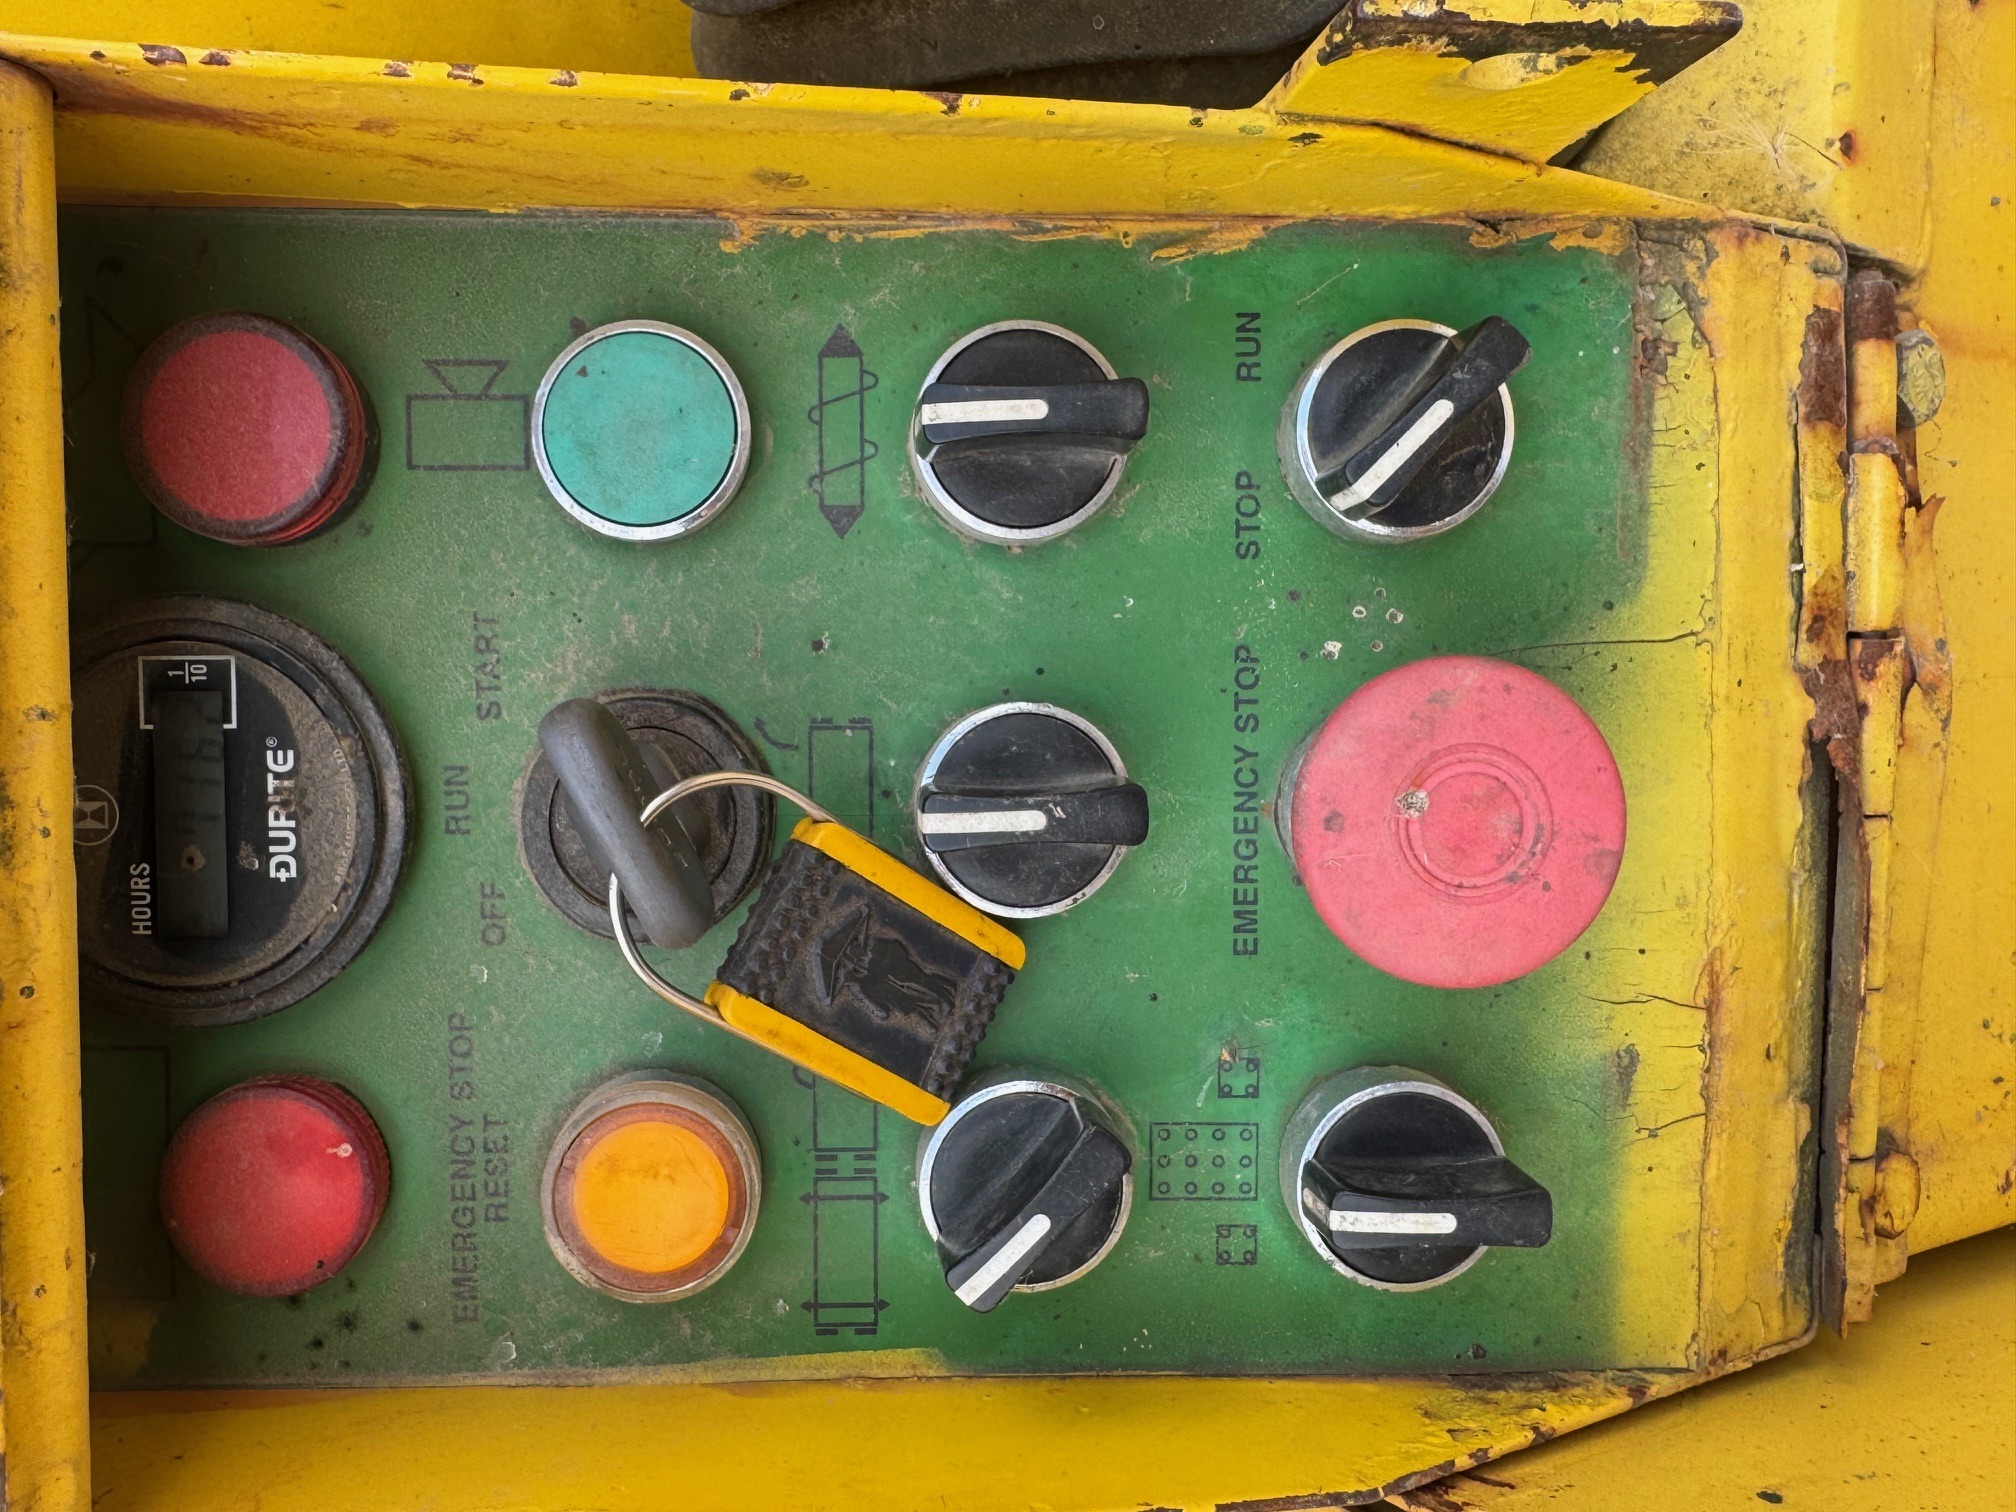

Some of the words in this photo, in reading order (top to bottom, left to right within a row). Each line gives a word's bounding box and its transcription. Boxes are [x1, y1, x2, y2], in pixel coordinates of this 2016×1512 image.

[1235, 312, 1262, 382] RUN
[1235, 470, 1262, 561] STOP
[473, 610, 502, 721] START
[1233, 645, 1260, 733] STOP
[443, 765, 471, 836] RUN
[1233, 743, 1260, 956] EMERGENCY
[130, 862, 152, 935] HOURS
[481, 882, 506, 947] OFF
[449, 1010, 474, 1100] STOP
[483, 1113, 511, 1223] RESET
[449, 1113, 480, 1323] EMERGENCY
